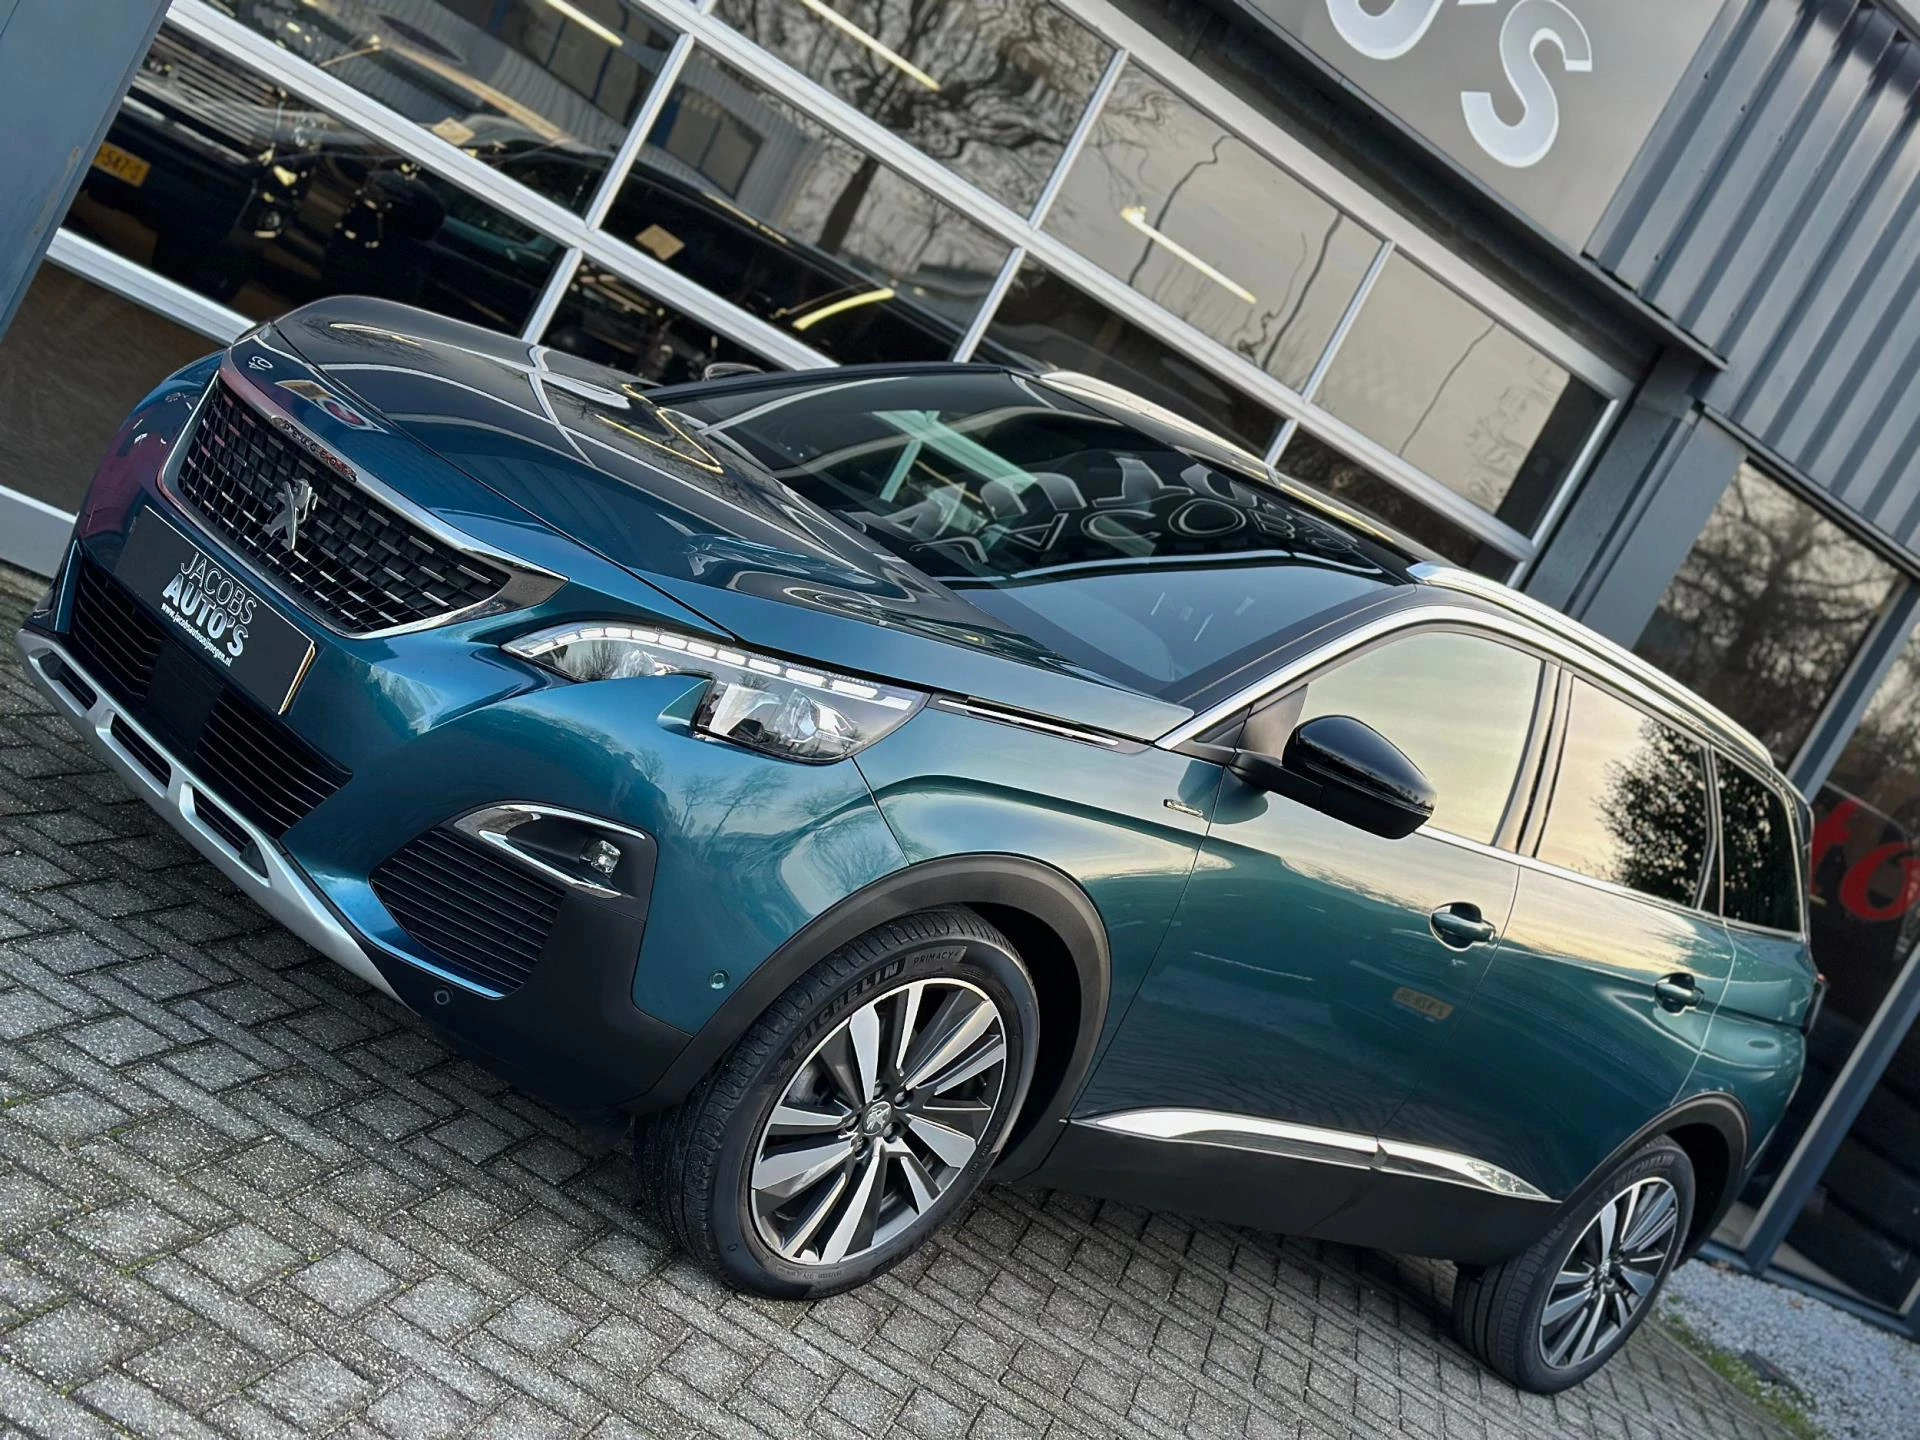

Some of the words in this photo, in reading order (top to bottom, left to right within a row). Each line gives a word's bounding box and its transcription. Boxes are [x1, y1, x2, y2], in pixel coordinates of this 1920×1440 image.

[162, 574, 248, 657] AUTO'S
[180, 552, 257, 625] JACOBS
[792, 961, 900, 1056] MICHELIN
[913, 951, 954, 966] PRIMACY
